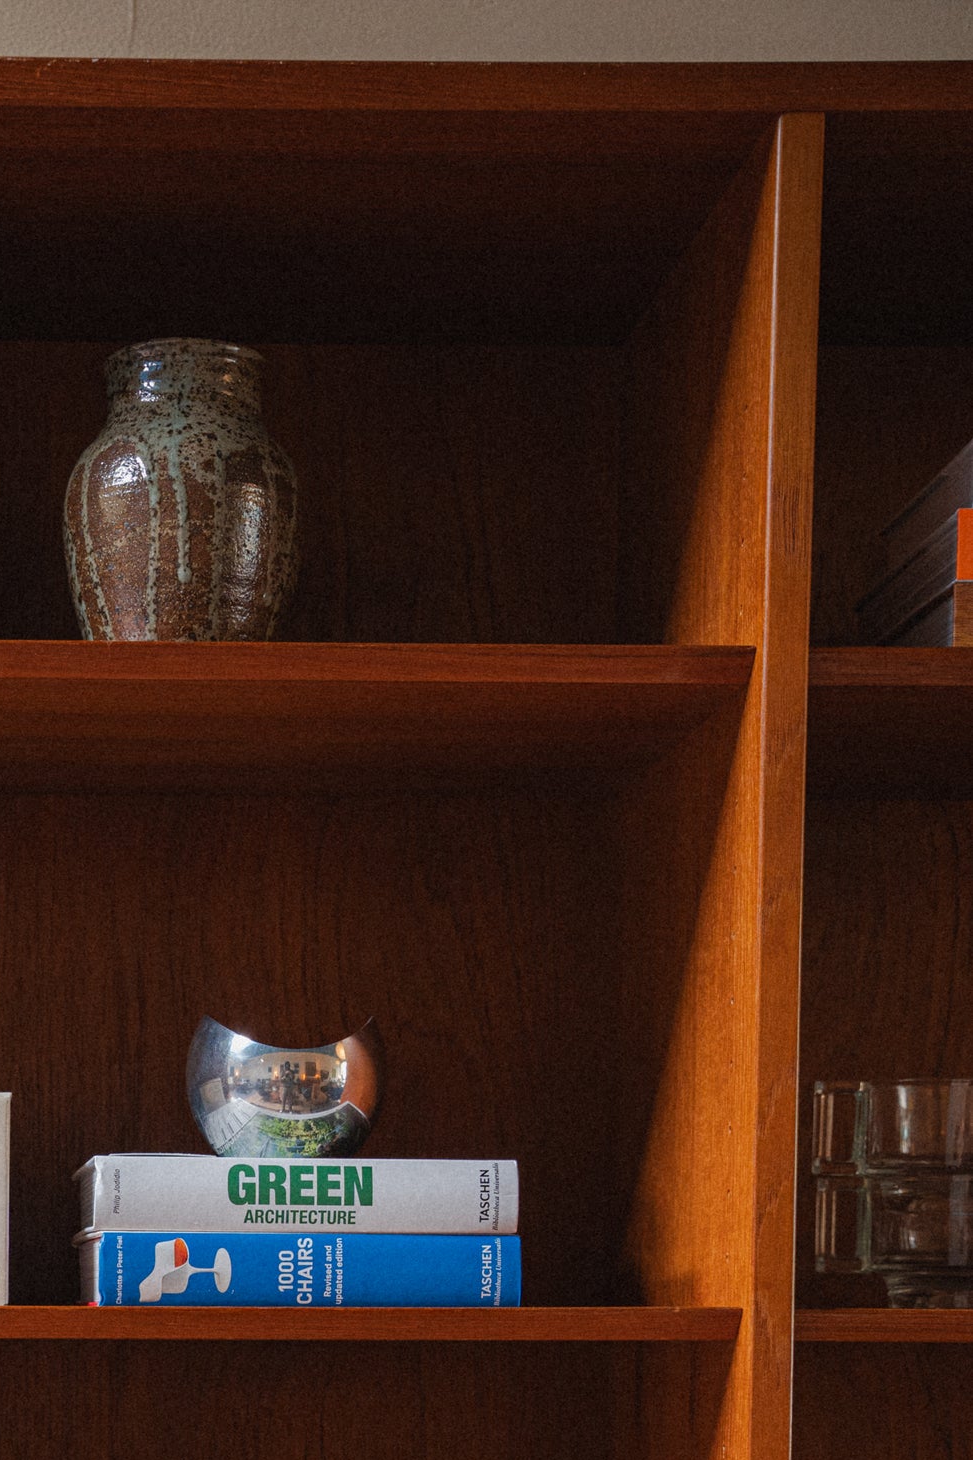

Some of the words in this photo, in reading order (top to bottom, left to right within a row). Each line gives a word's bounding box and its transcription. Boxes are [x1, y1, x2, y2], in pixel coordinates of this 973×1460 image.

[228, 1164, 373, 1206] GREEN
[478, 1168, 491, 1224] TASCHEN
[113, 1194, 121, 1214] Philip
[243, 1209, 357, 1226] ARCHITECTURE
[323, 1245, 333, 1263] and
[335, 1237, 344, 1268] edition
[278, 1250, 294, 1292] 1000
[296, 1237, 314, 1305] CHAIRS
[323, 1263, 333, 1298] Revised
[334, 1269, 344, 1305] updated
[481, 1244, 492, 1299] TASCHEN
